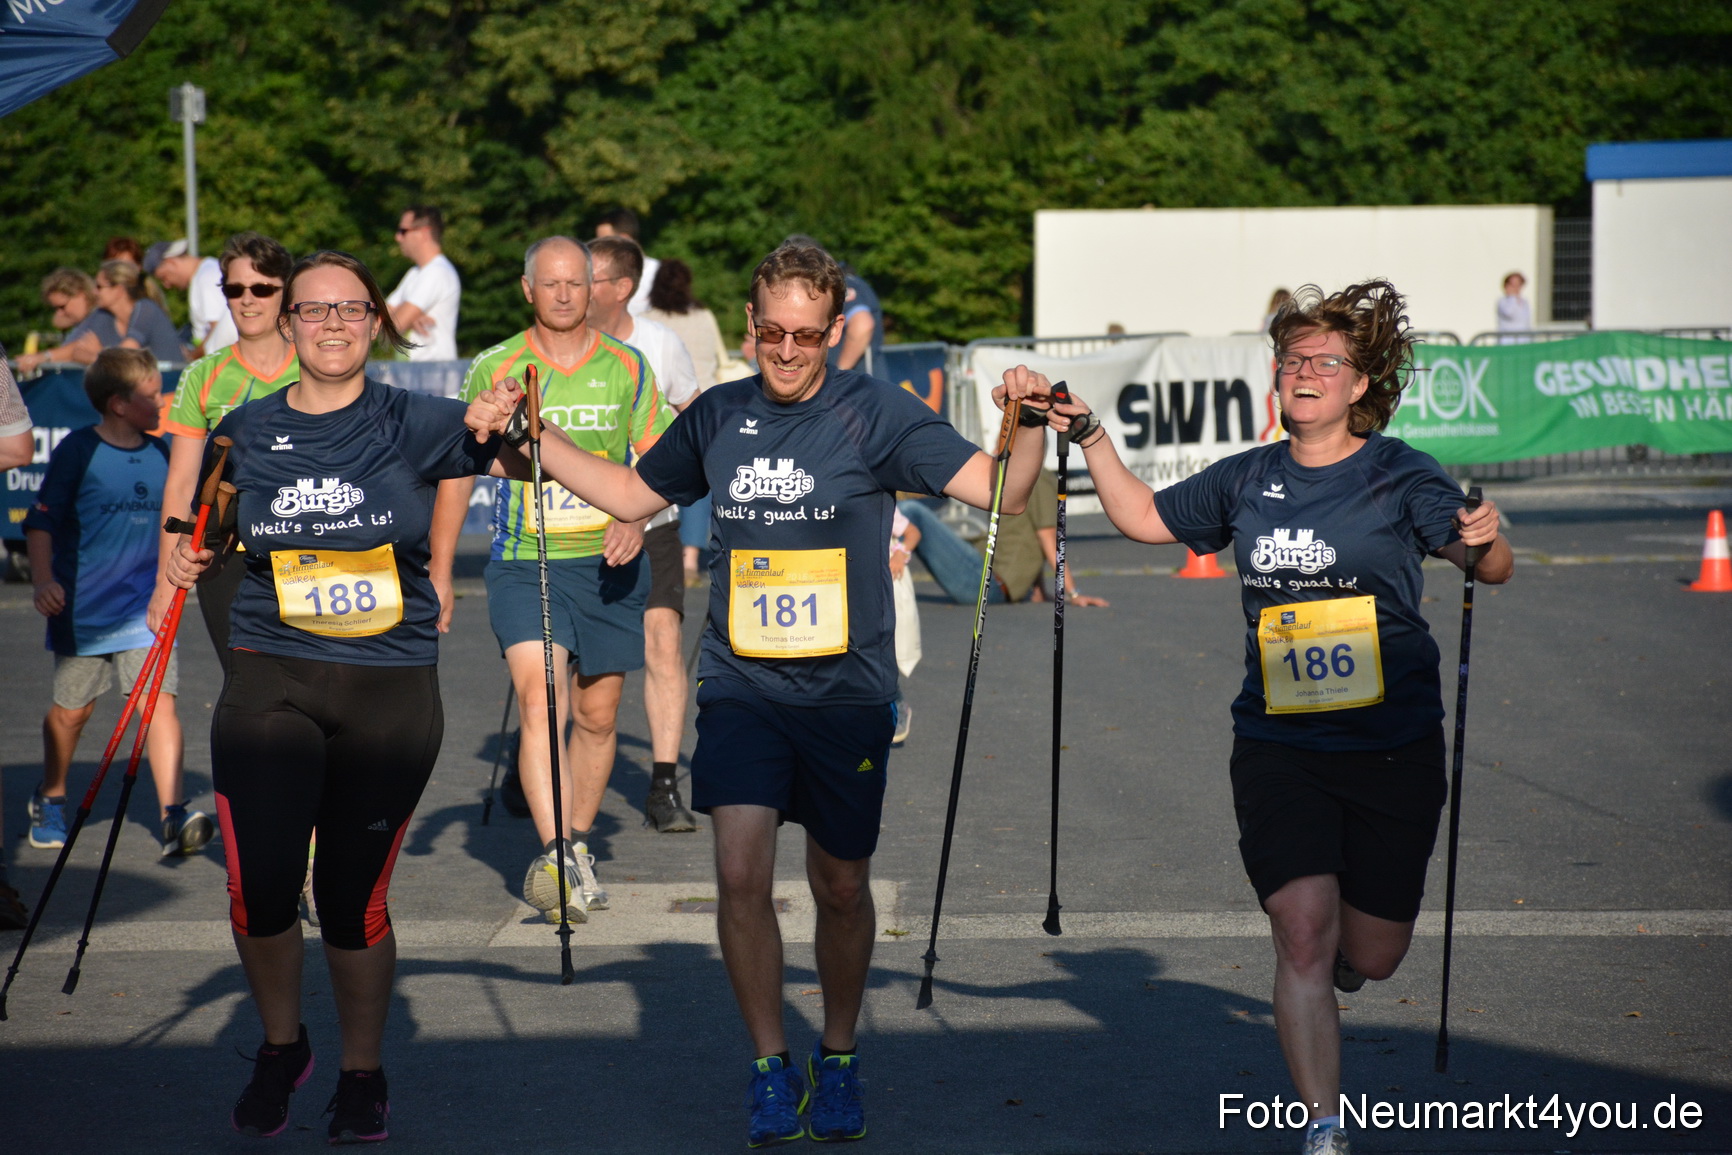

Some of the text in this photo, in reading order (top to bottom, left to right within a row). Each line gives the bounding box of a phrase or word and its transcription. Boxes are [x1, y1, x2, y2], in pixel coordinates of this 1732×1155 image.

[1393, 358, 1498, 420] AOK
[540, 404, 622, 431] OCK
[739, 427, 758, 435] erima
[271, 443, 293, 451] erima
[729, 465, 815, 504] Burgis
[1262, 490, 1285, 499] erima
[271, 482, 365, 518] Burgis
[251, 510, 393, 537] Weil's guad is!
[716, 505, 835, 525] Weil's guad is!
[985, 510, 999, 555] LEKI
[292, 561, 334, 572] firmenlauf
[1251, 535, 1336, 574] Burgis
[746, 568, 785, 577] firmenlauf
[1242, 573, 1357, 591] Weil's guad is!
[304, 580, 377, 616] 188
[753, 593, 818, 628] 181
[761, 635, 788, 643] Thomas
[1283, 643, 1355, 682] 186
[1295, 687, 1349, 698] Johanna Thiele
